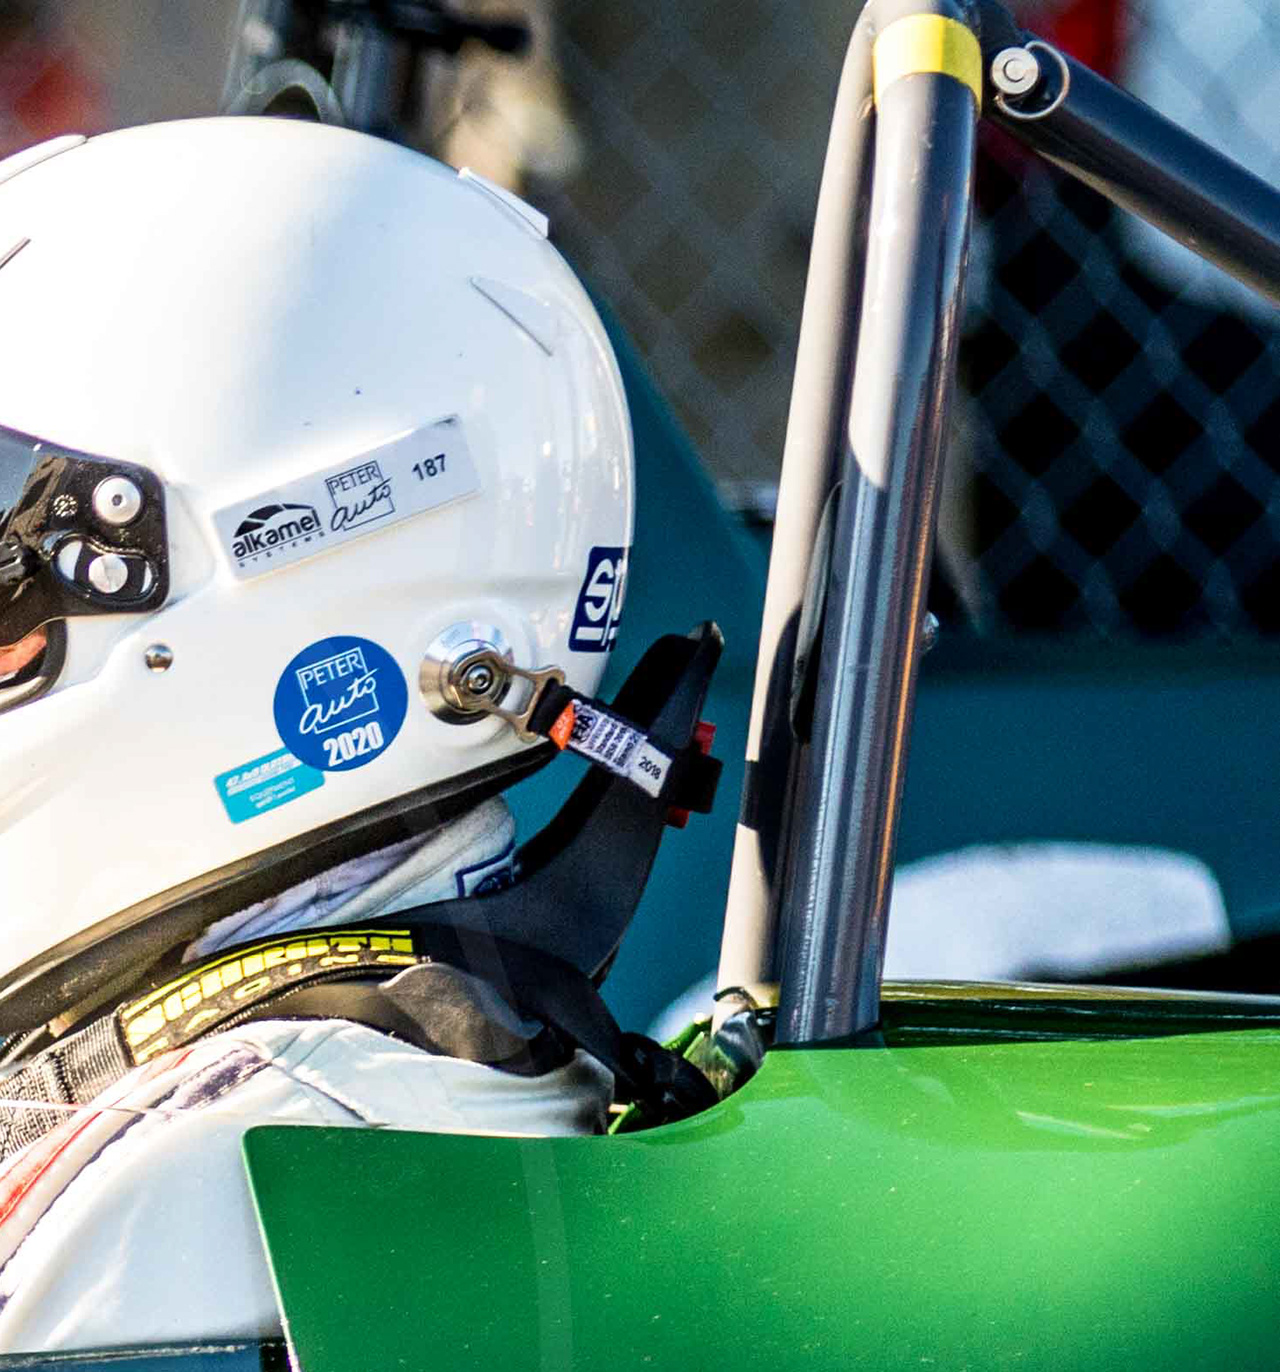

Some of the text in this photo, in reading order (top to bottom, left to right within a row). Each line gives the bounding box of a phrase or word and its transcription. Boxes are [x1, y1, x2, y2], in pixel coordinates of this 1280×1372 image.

[329, 466, 380, 496] PETER
[412, 454, 446, 482] 187
[330, 476, 393, 532] auto
[232, 508, 321, 559] alkamel
[301, 653, 363, 689] PETER
[298, 667, 380, 735] auto
[322, 721, 384, 768] 2020
[637, 755, 663, 780] 2018
